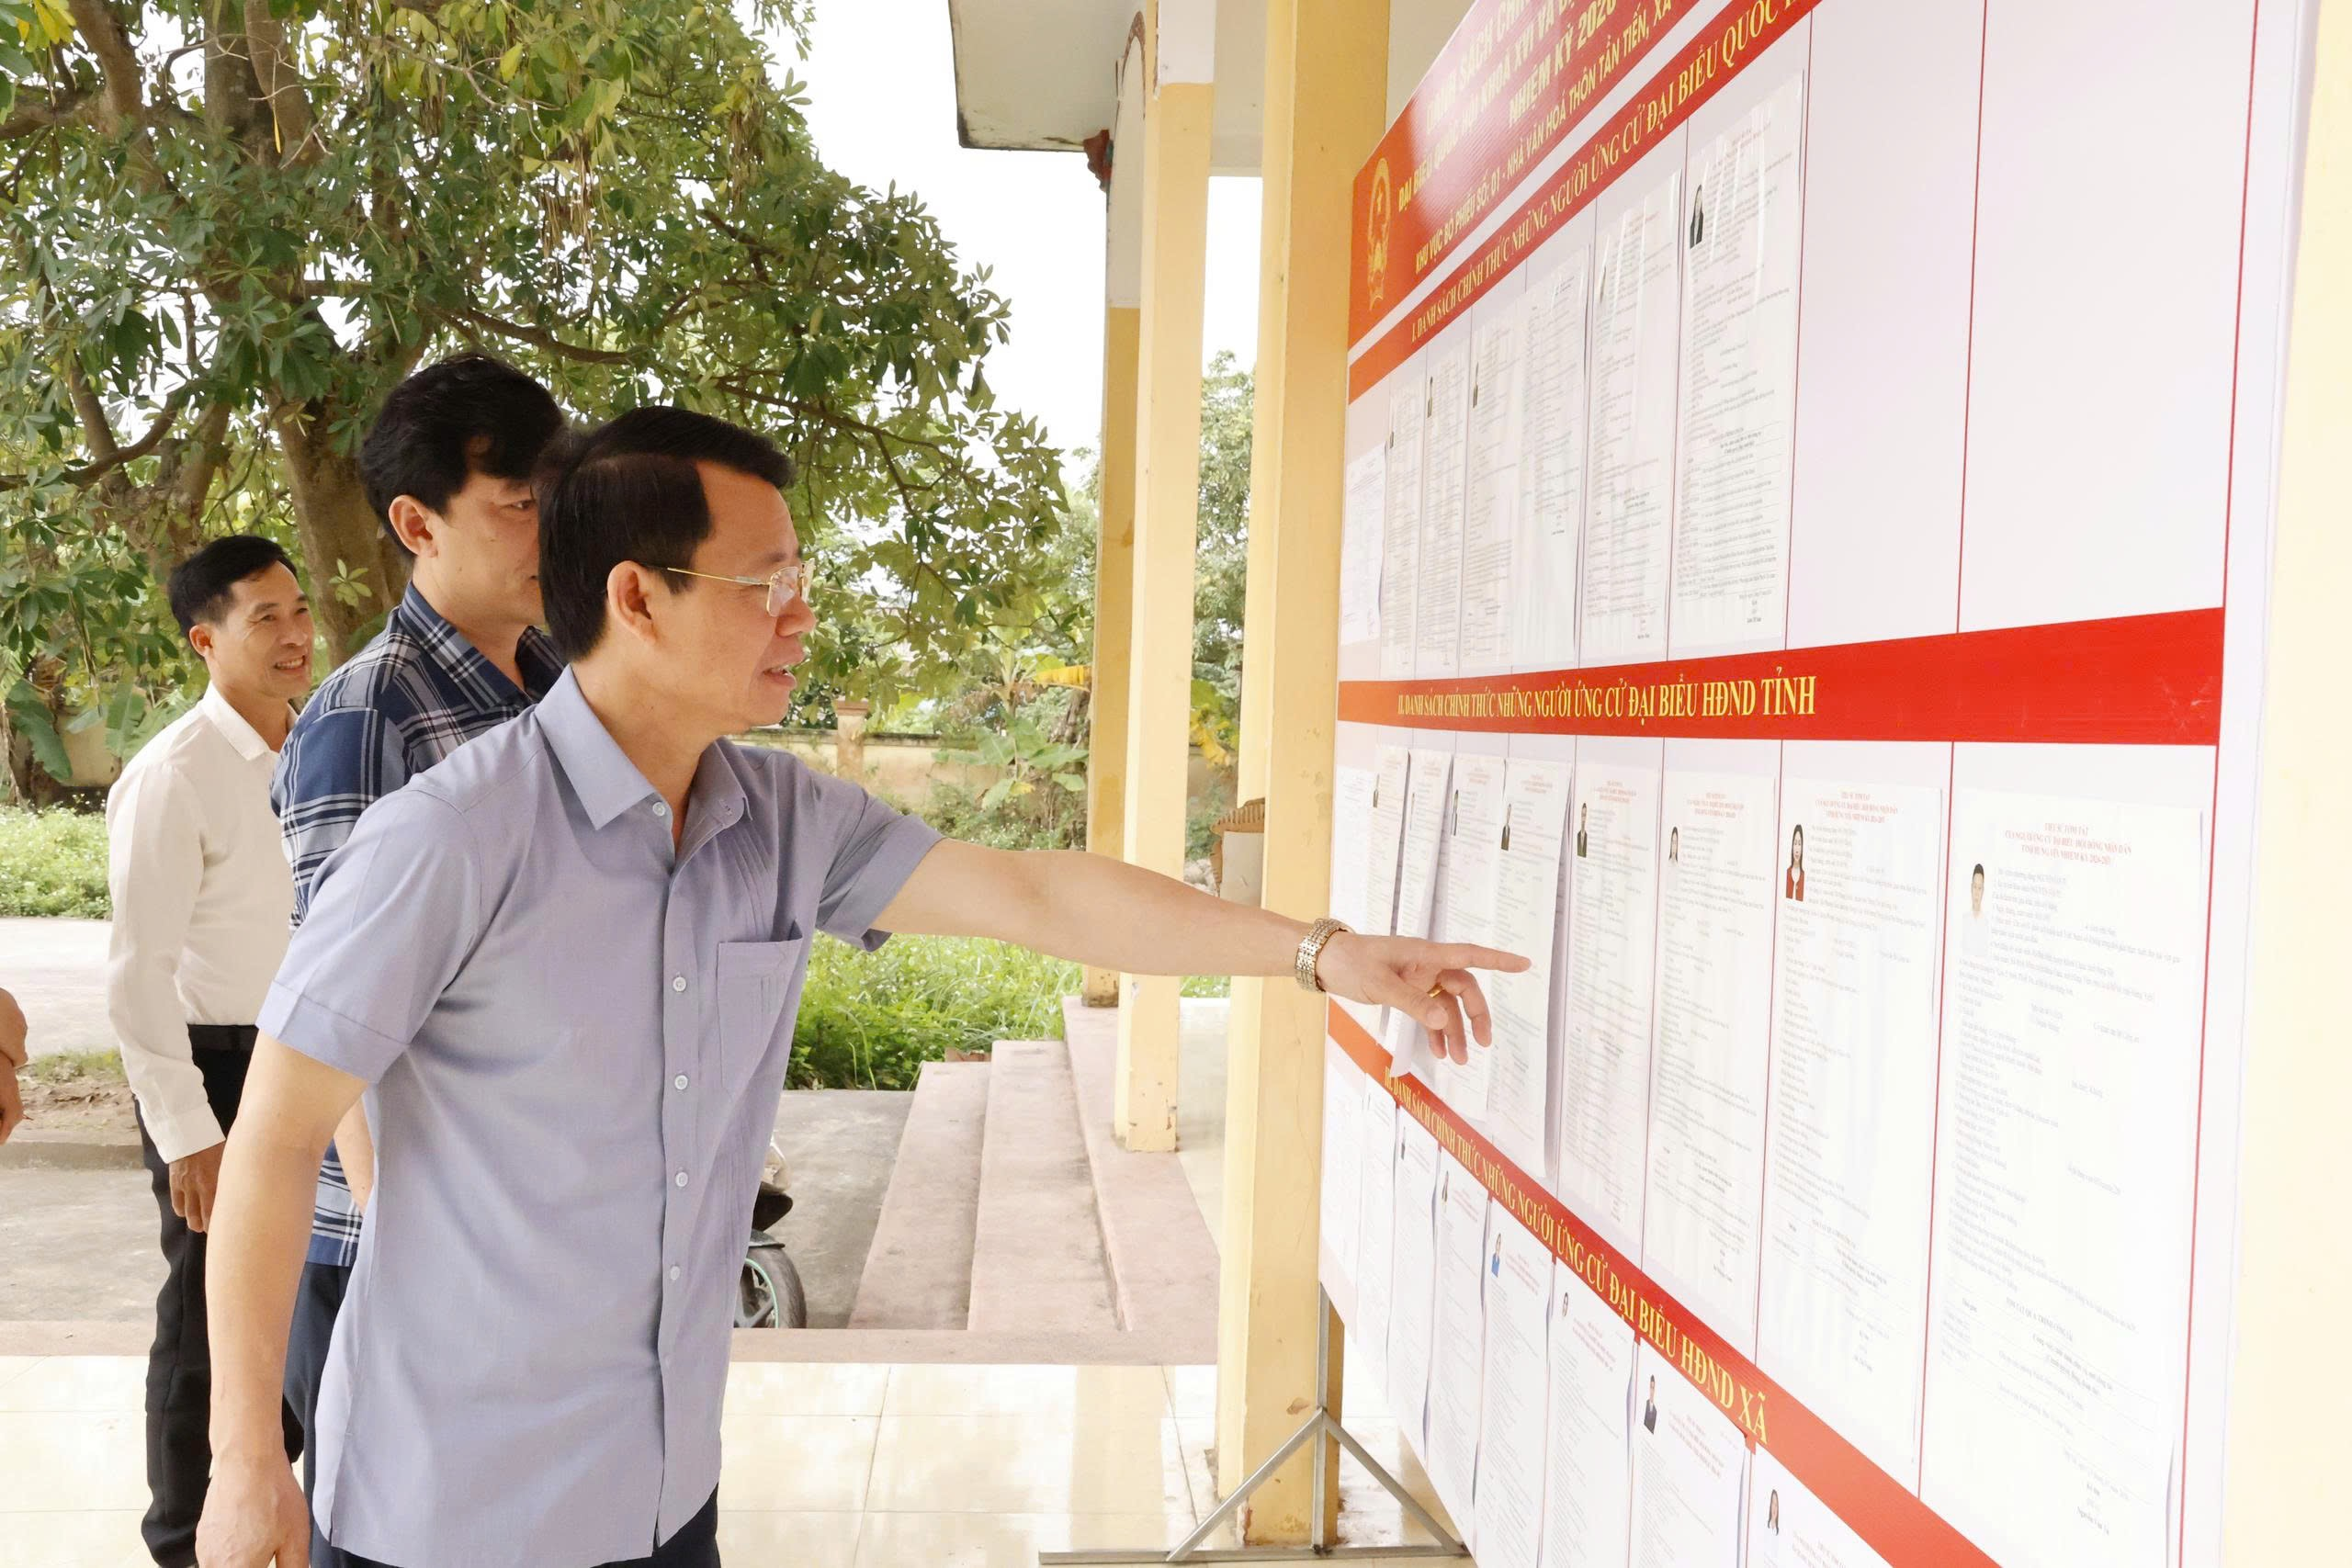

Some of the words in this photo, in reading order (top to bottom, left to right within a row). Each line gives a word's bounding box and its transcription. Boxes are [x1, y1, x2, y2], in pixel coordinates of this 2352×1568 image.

[1398, 176, 1412, 212] ĐẠI
[1514, 21, 1534, 72] XVI
[1416, 243, 1429, 275] KHU
[1430, 228, 1443, 263] VỰC
[1507, 137, 1525, 180] NHÀ
[1526, 121, 1544, 160] VĂN
[1545, 89, 1566, 141] HOÁ
[1569, 66, 1596, 114] THÔN
[1623, 2, 1649, 57] TIẾN,
[1418, 303, 1436, 338] DANH
[1437, 288, 1456, 321] SÁCH
[1457, 261, 1484, 302] CHÍNH
[1485, 235, 1510, 279] THỨC
[1511, 201, 1547, 255] NHỮNG
[1550, 161, 1588, 221] NGƯỜI
[1592, 133, 1620, 182] ỨNG
[1623, 104, 1645, 153] CỬ
[1647, 82, 1674, 134] ĐẠI
[1678, 39, 1718, 106] BIỂU
[1509, 53, 1551, 128] NHIỆM
[1555, 22, 1574, 75] KỲ
[1405, 694, 1423, 716] DANH
[1424, 687, 1443, 716] SÁCH
[1444, 687, 1470, 716] CHÍNH
[1472, 686, 1496, 716] THỨC
[1498, 685, 1532, 716] NHỮNG
[1534, 681, 1572, 716] NGƯỜI
[1575, 680, 1602, 716] ỨNG
[1605, 678, 1627, 716] CỬ
[1628, 685, 1656, 726] ĐẠI
[1658, 673, 1699, 716] BIỂU
[1702, 681, 1756, 716] HĐND
[1760, 666, 1816, 716] TỈNH
[1394, 1076, 1411, 1111] DANH
[1412, 1090, 1430, 1129] SÁCH
[1431, 1111, 1455, 1153] CHÍNH
[1457, 1135, 1480, 1177] THỨC
[1482, 1157, 1516, 1210] NHỮNG
[1518, 1190, 1554, 1247] NGƯỜI
[1557, 1219, 1584, 1273] ỨNG
[1587, 1254, 1608, 1292] CỬ
[1610, 1271, 1635, 1323] ĐẠI
[1639, 1297, 1678, 1358] BIỂU
[1681, 1334, 1734, 1409] HĐND
[1738, 1385, 1768, 1445] XÃ
